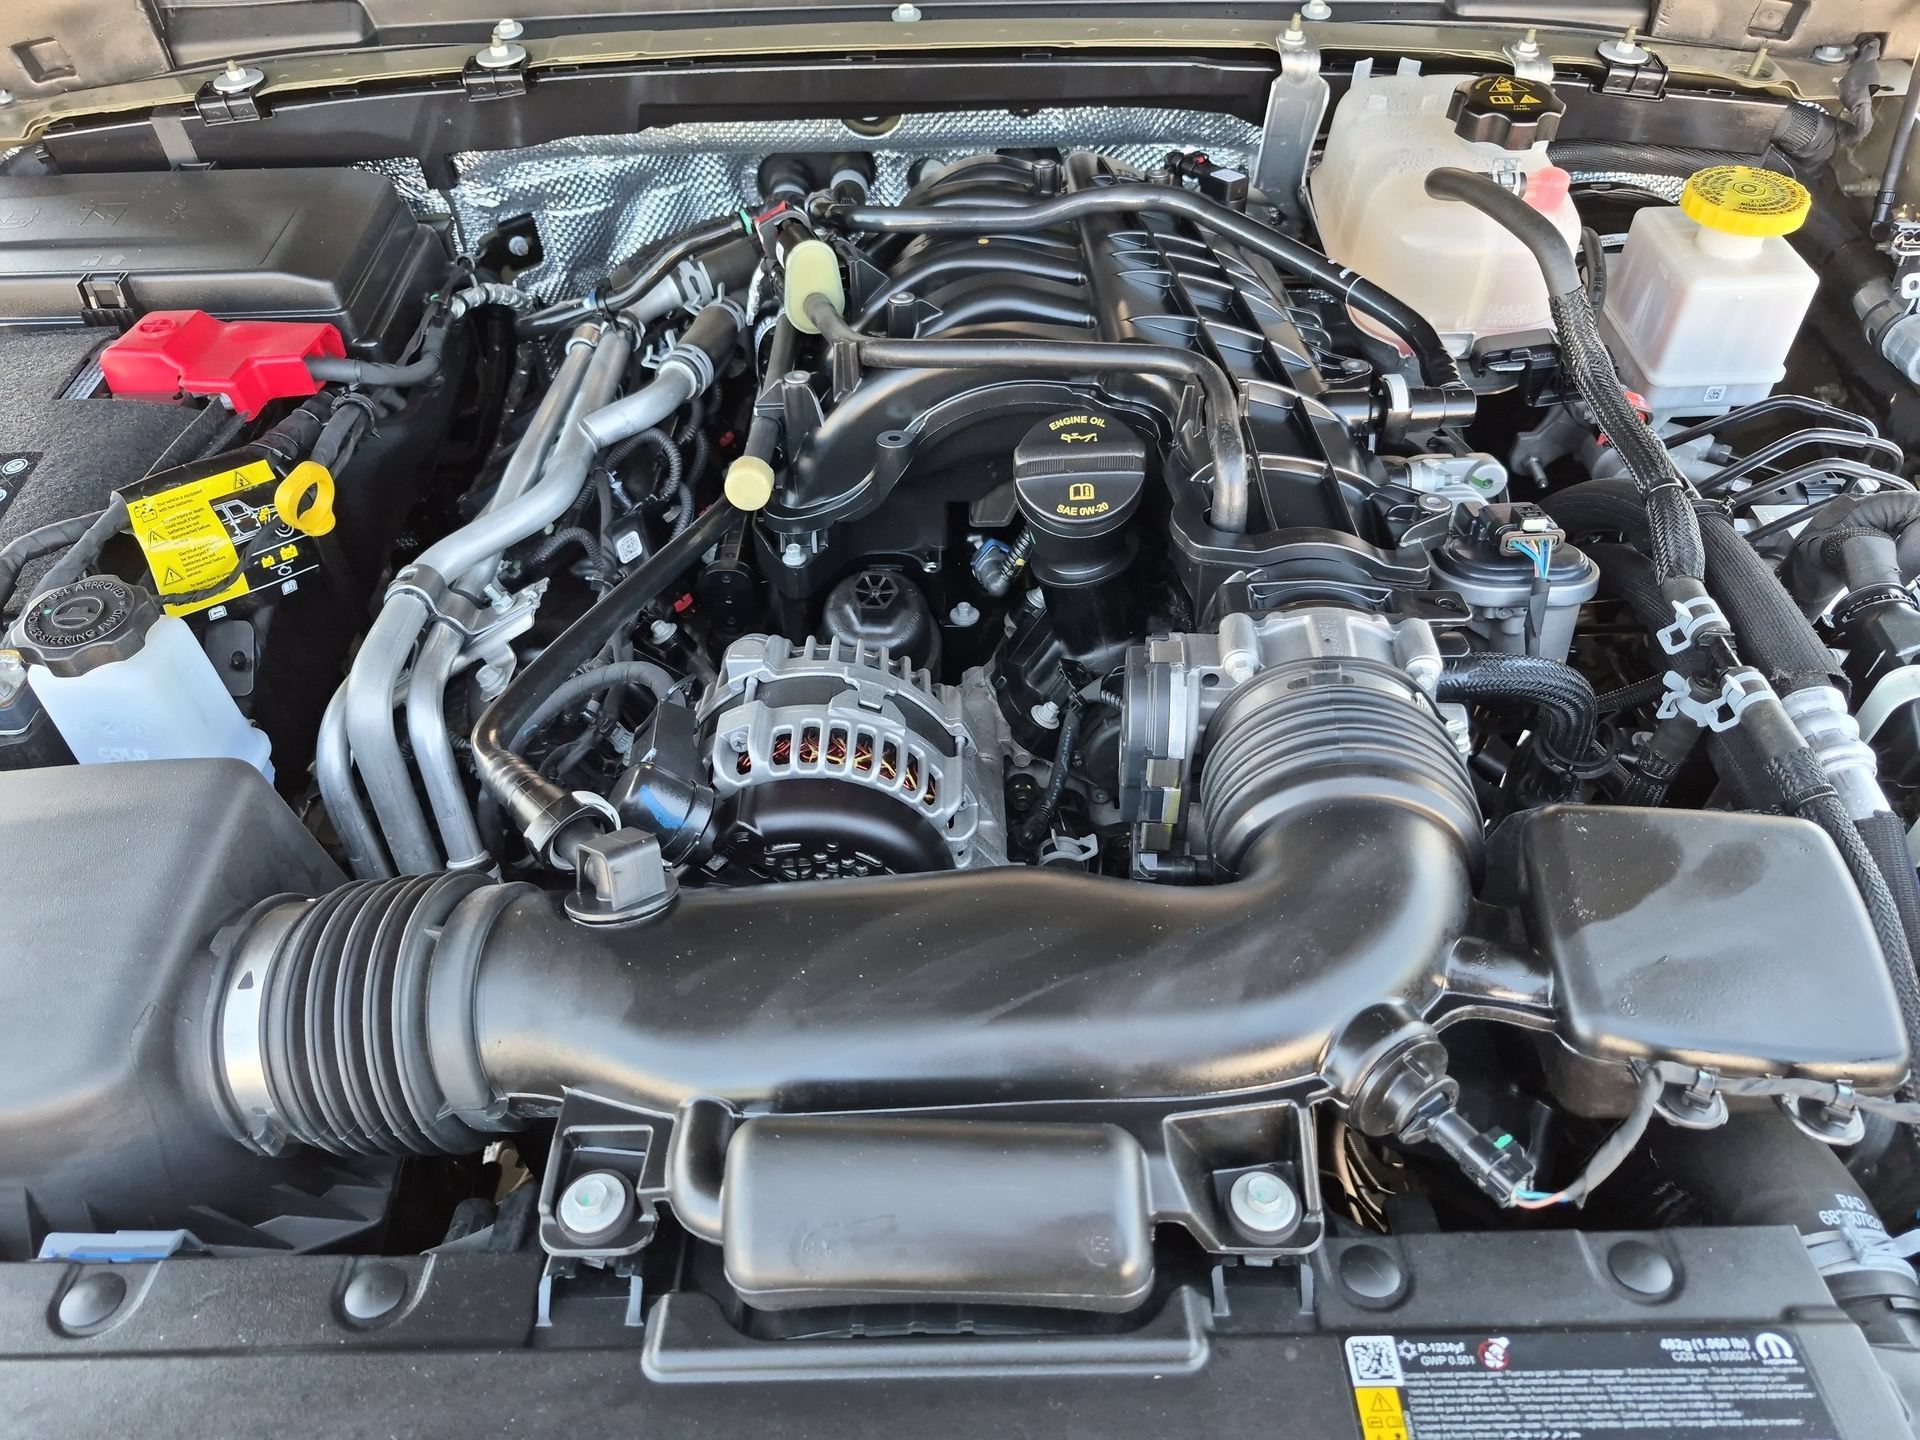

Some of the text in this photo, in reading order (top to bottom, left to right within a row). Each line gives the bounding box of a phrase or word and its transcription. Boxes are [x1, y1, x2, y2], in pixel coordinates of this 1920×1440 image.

[1049, 416, 1106, 431] ENGINE OIL
[183, 489, 202, 498] equipped
[1056, 501, 1109, 516] SAE 0W-20
[170, 529, 197, 540] disconnected
[186, 550, 206, 560] damaged
[184, 561, 212, 572] disconnected
[48, 581, 125, 600] USE APPROVED
[42, 629, 95, 644] STEERING
[98, 609, 123, 632] FLUID
[1835, 1194, 1866, 1211] RAD
[1420, 1355, 1447, 1366] GWP
